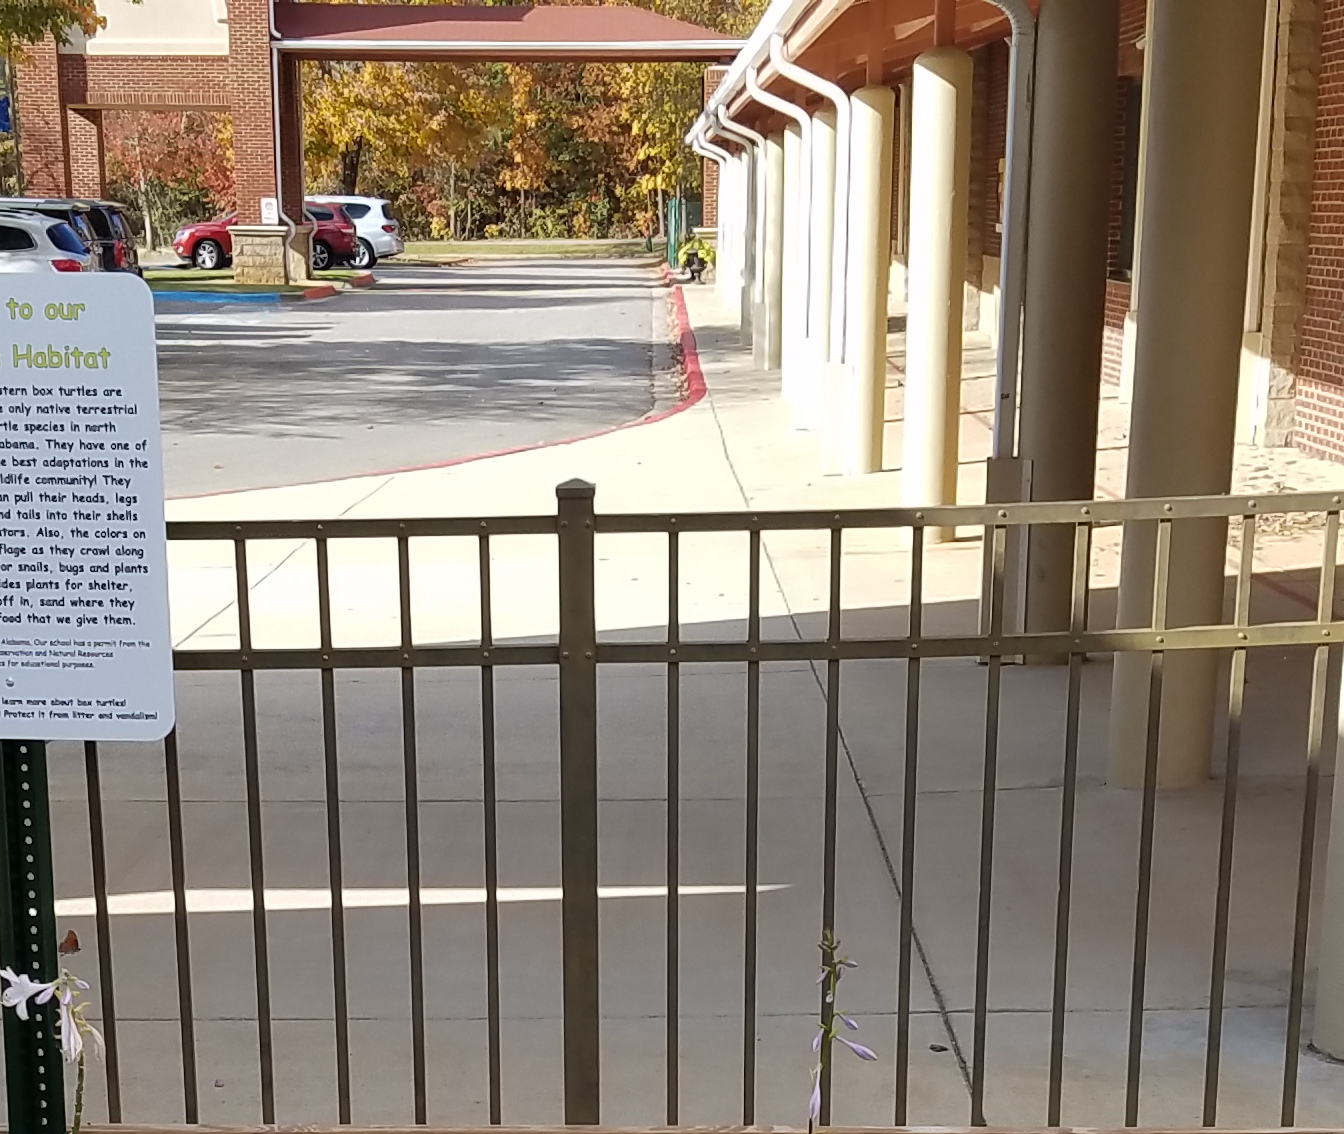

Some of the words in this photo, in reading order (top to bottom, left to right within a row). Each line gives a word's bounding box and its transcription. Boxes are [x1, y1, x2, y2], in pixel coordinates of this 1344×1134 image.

[6, 297, 34, 320] to
[44, 302, 86, 320] our
[12, 345, 111, 368] Habitat
[32, 385, 54, 397] box
[58, 385, 98, 397] turtles
[103, 389, 123, 397] are
[8, 402, 32, 417] only
[36, 403, 71, 414] native
[76, 403, 138, 415] terrestrial
[24, 420, 65, 435] species
[70, 421, 80, 432] in
[85, 421, 116, 432] north
[45, 438, 74, 453] They
[79, 439, 106, 450] have
[110, 442, 130, 450] one
[135, 439, 147, 451] of
[12, 456, 38, 467] best
[42, 456, 109, 471] adaptations
[114, 457, 125, 468] in
[129, 457, 148, 468] the
[35, 474, 97, 488] community!
[102, 475, 132, 489] They
[14, 491, 34, 505] pull
[38, 491, 67, 503] their
[72, 492, 109, 505] heads,
[115, 492, 138, 507] legs
[16, 508, 41, 520] tails
[46, 509, 68, 520] into
[73, 509, 101, 521] their
[106, 509, 138, 521] shells
[36, 526, 64, 539] Also,
[70, 527, 90, 538] the
[94, 527, 128, 539] colors
[133, 531, 146, 539] on
[32, 547, 44, 555] as
[49, 544, 75, 558] they
[80, 544, 110, 556] crawl
[115, 544, 144, 559] along
[18, 561, 53, 574] snails,
[59, 562, 85, 576] bugs
[89, 562, 110, 573] and
[114, 562, 149, 576] plants
[26, 578, 60, 593] plants
[65, 578, 83, 591] for
[88, 579, 133, 592] shelter,
[20, 596, 34, 609] in,
[40, 596, 65, 607] sand
[70, 596, 105, 607] where
[109, 597, 135, 611] they
[27, 612, 51, 624] that
[56, 616, 71, 624] we
[76, 613, 98, 628] give
[103, 614, 136, 625] them.
[1, 696, 23, 705] learn
[50, 698, 74, 707] about
[77, 698, 93, 707] box
[4, 709, 35, 718] Protect
[38, 710, 45, 719] it
[49, 710, 70, 719] from
[72, 711, 95, 719] litter
